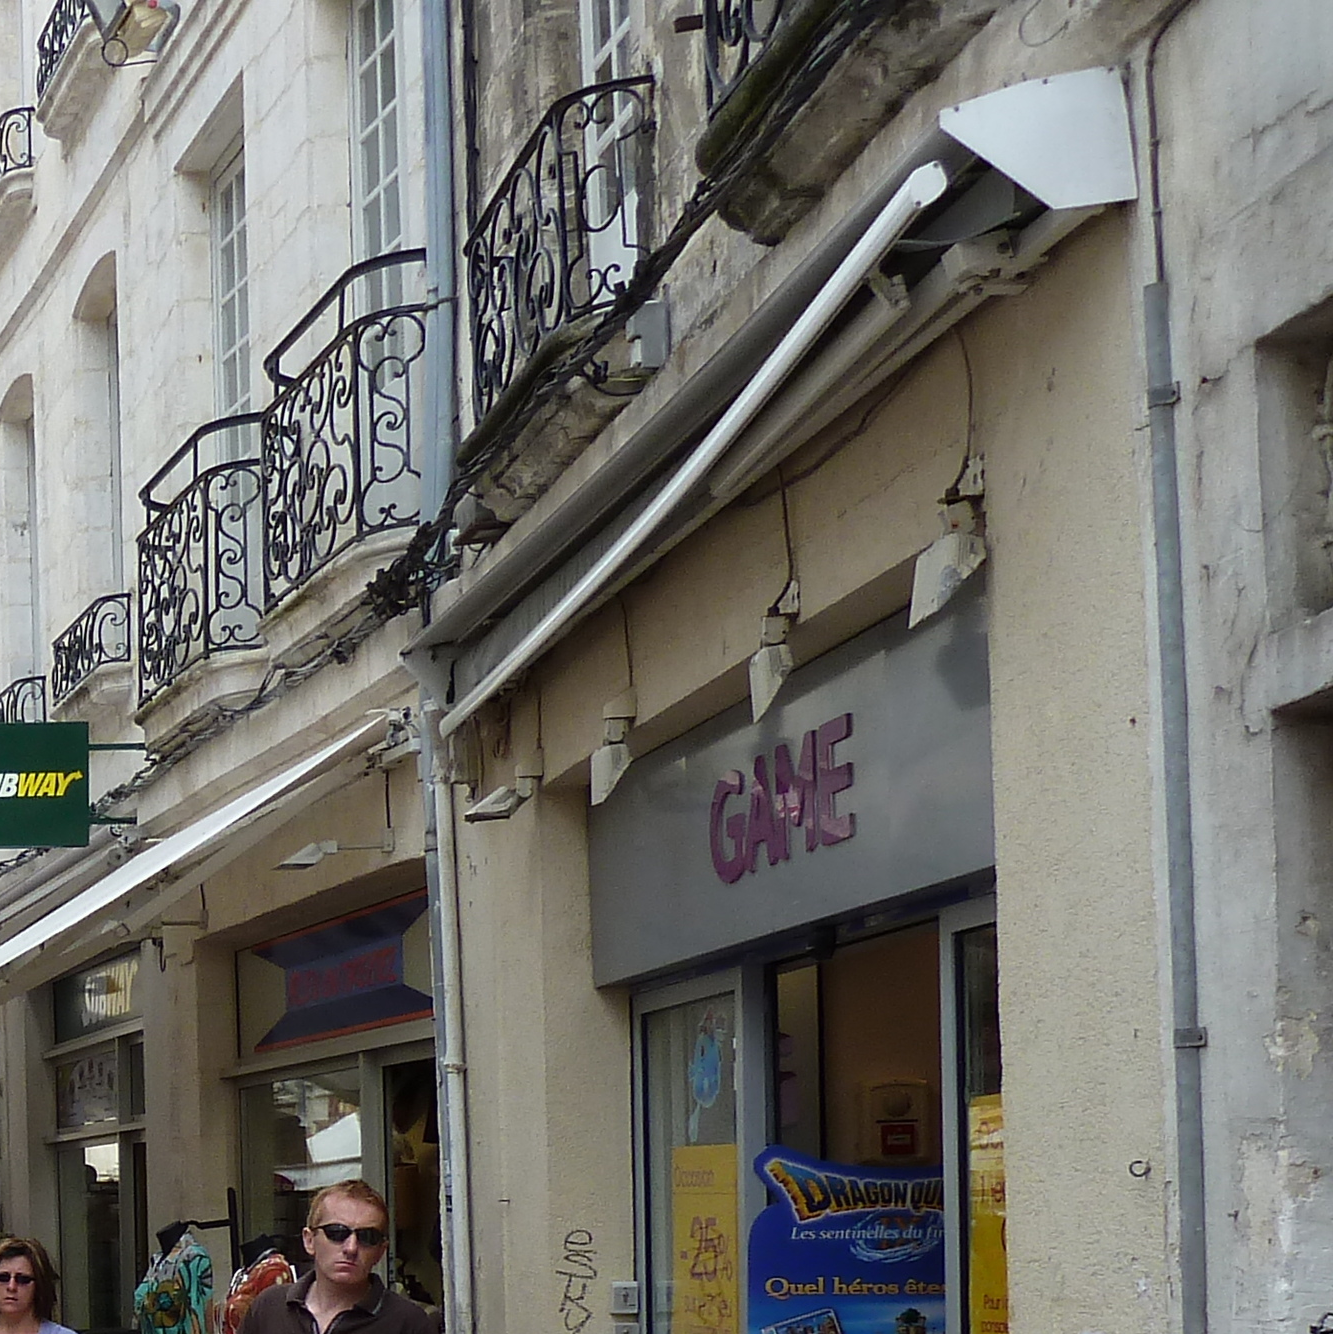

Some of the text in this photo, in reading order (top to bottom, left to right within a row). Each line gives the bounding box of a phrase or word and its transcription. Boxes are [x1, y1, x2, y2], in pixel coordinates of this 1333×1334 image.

[710, 713, 856, 884] GAME
[765, 1159, 909, 1223] DRAGON
[791, 1228, 815, 1240] Les
[818, 1224, 898, 1240] sentinelles
[902, 1224, 923, 1240] du
[765, 1277, 825, 1300] Quel
[833, 1277, 898, 1295] héros
